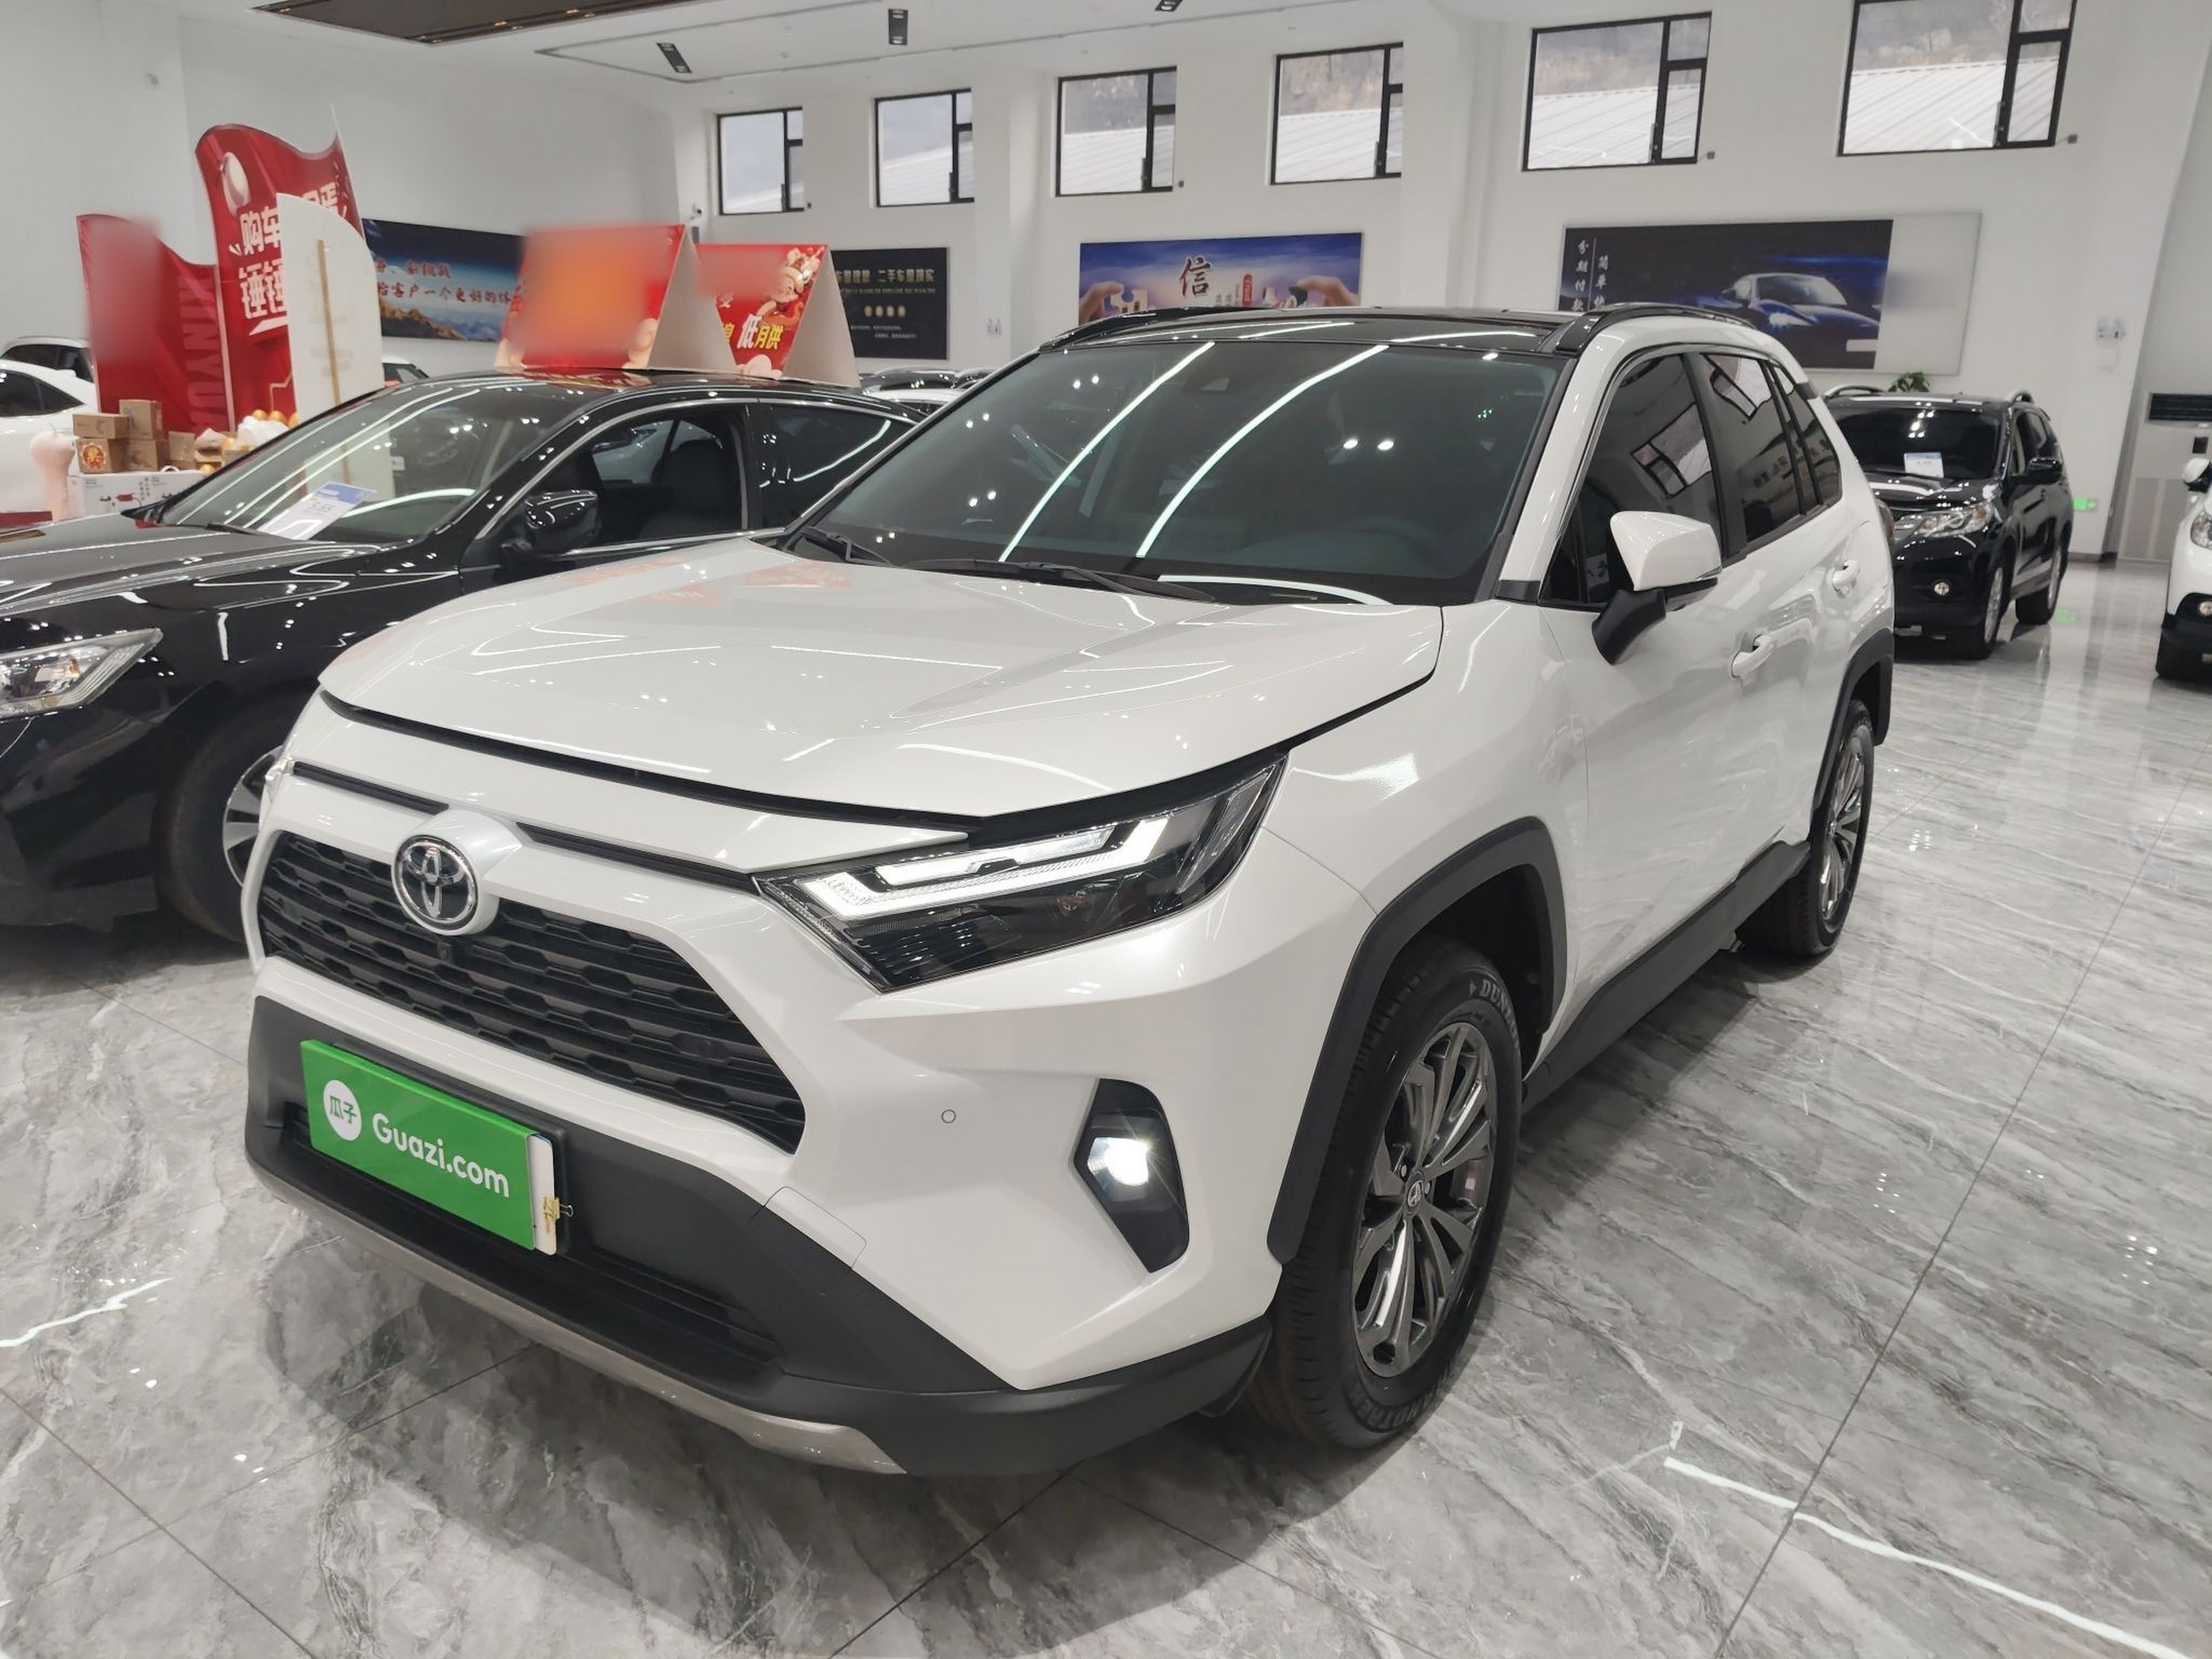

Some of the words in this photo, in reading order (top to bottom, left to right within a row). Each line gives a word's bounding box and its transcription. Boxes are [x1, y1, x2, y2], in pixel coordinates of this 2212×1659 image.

[1179, 257, 1211, 297] 信
[737, 313, 784, 350] 低月供
[329, 1094, 357, 1124] 瓜子
[372, 1112, 510, 1198] Guazi.com
